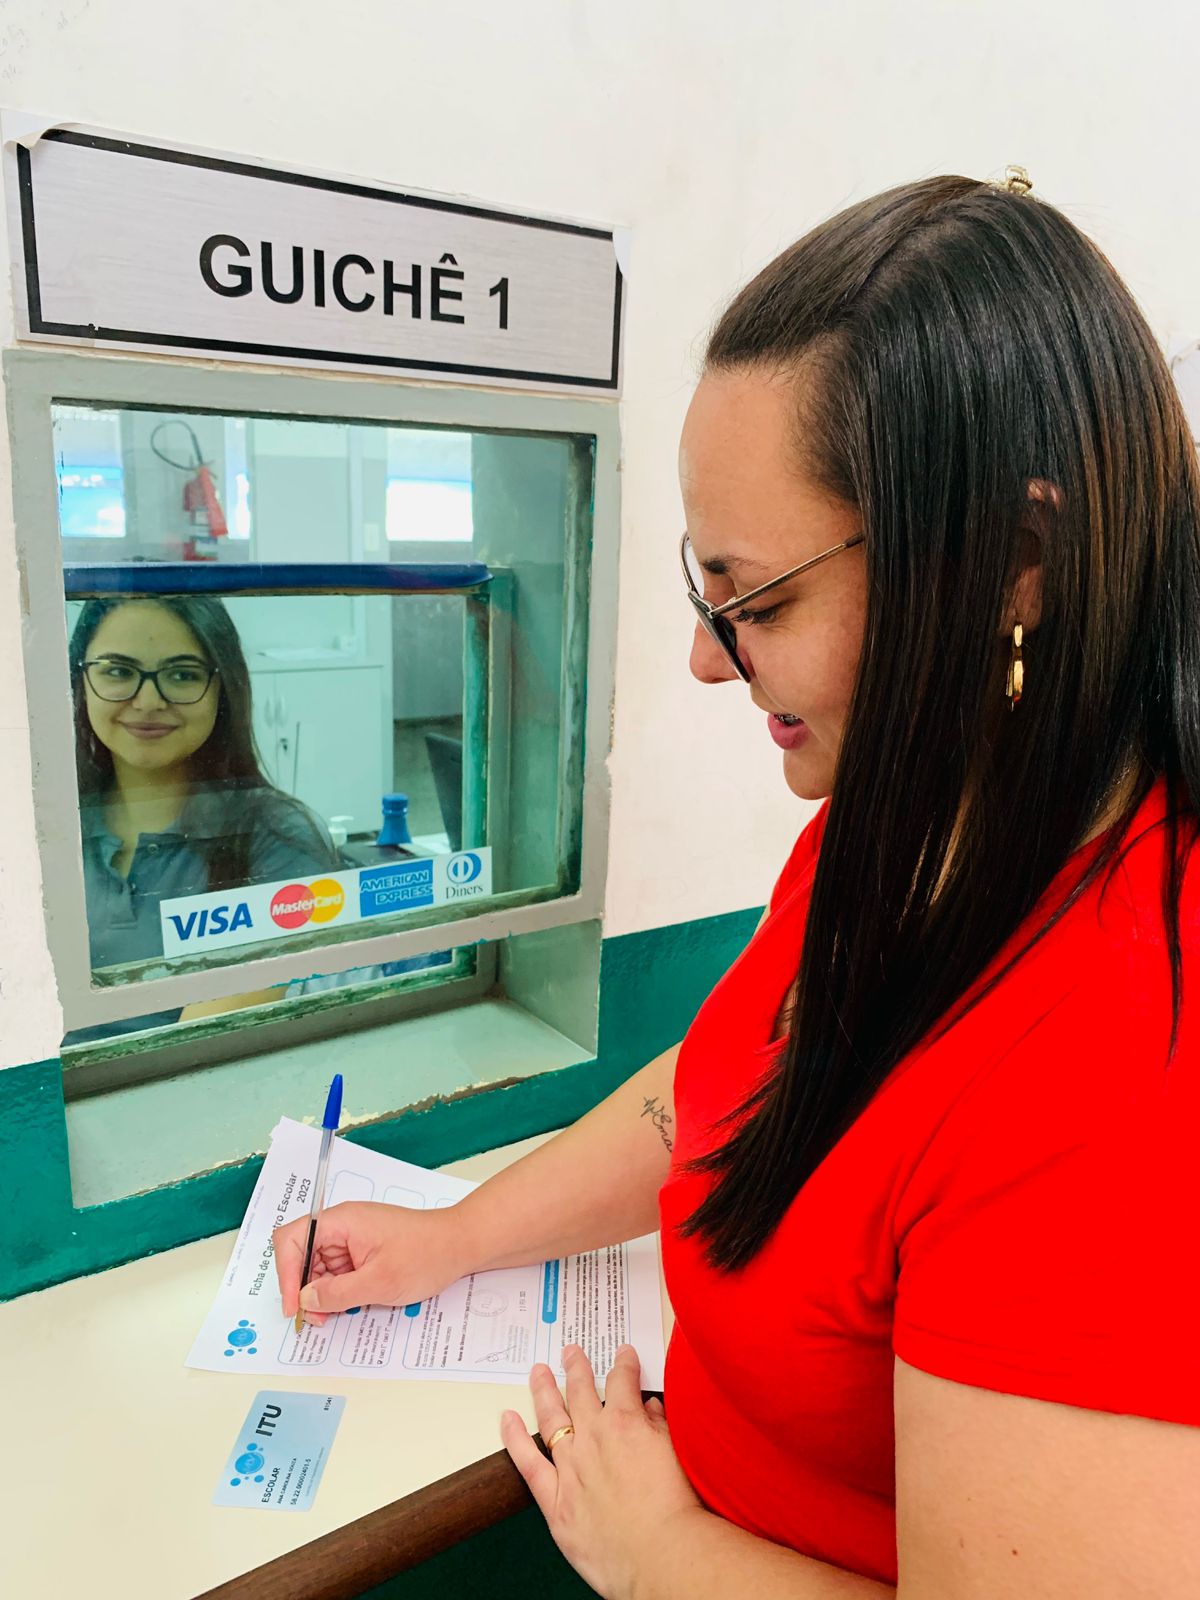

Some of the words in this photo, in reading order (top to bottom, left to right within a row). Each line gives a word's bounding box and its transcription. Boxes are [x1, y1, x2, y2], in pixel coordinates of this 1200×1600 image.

[199, 234, 465, 325] GUICHÊ
[488, 276, 509, 329] 1
[360, 871, 430, 893] AMERICAN
[375, 885, 434, 906] EXPRESS
[446, 883, 483, 900] Diners
[271, 892, 343, 916] MasterCard
[165, 902, 254, 941] VISA
[296, 1178, 312, 1204] 2023
[248, 1271, 266, 1297] Ficha
[260, 1257, 270, 1273] de
[277, 1172, 298, 1214] Escolar
[255, 1403, 282, 1437] ITU
[261, 1466, 281, 1503] ESCOLAR
